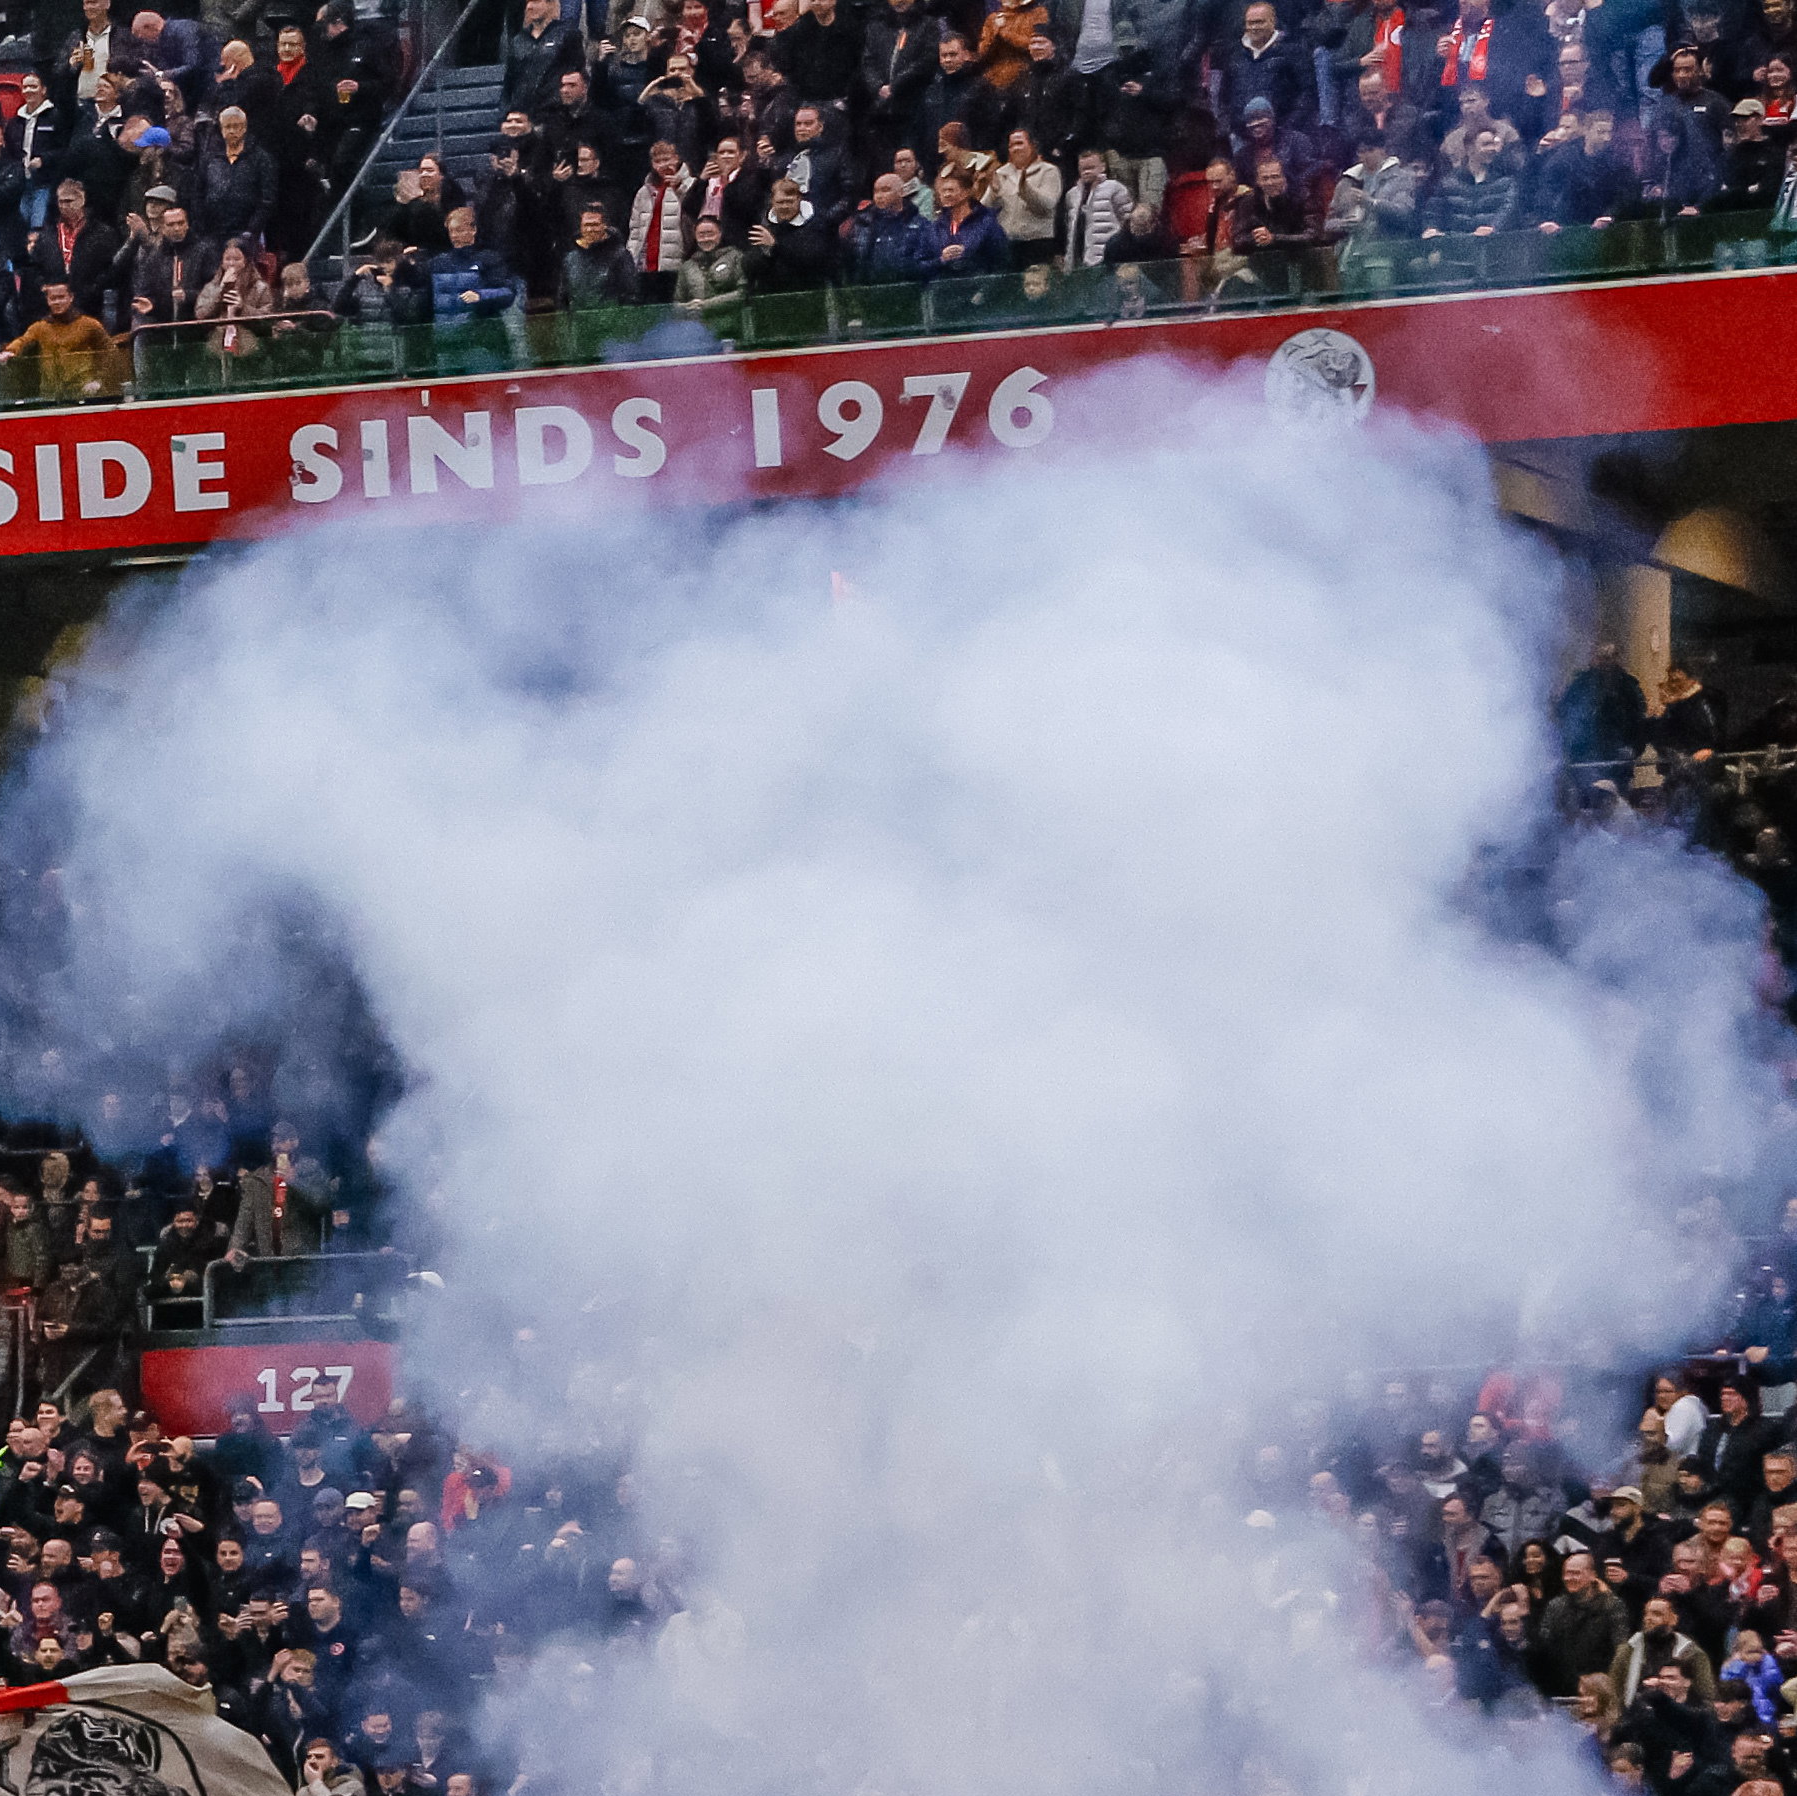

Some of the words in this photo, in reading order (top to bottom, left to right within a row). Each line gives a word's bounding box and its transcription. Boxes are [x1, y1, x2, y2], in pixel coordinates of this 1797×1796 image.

[289, 396, 666, 504] SINDS
[751, 366, 1055, 468] 1976
[257, 1365, 354, 1413] 127
